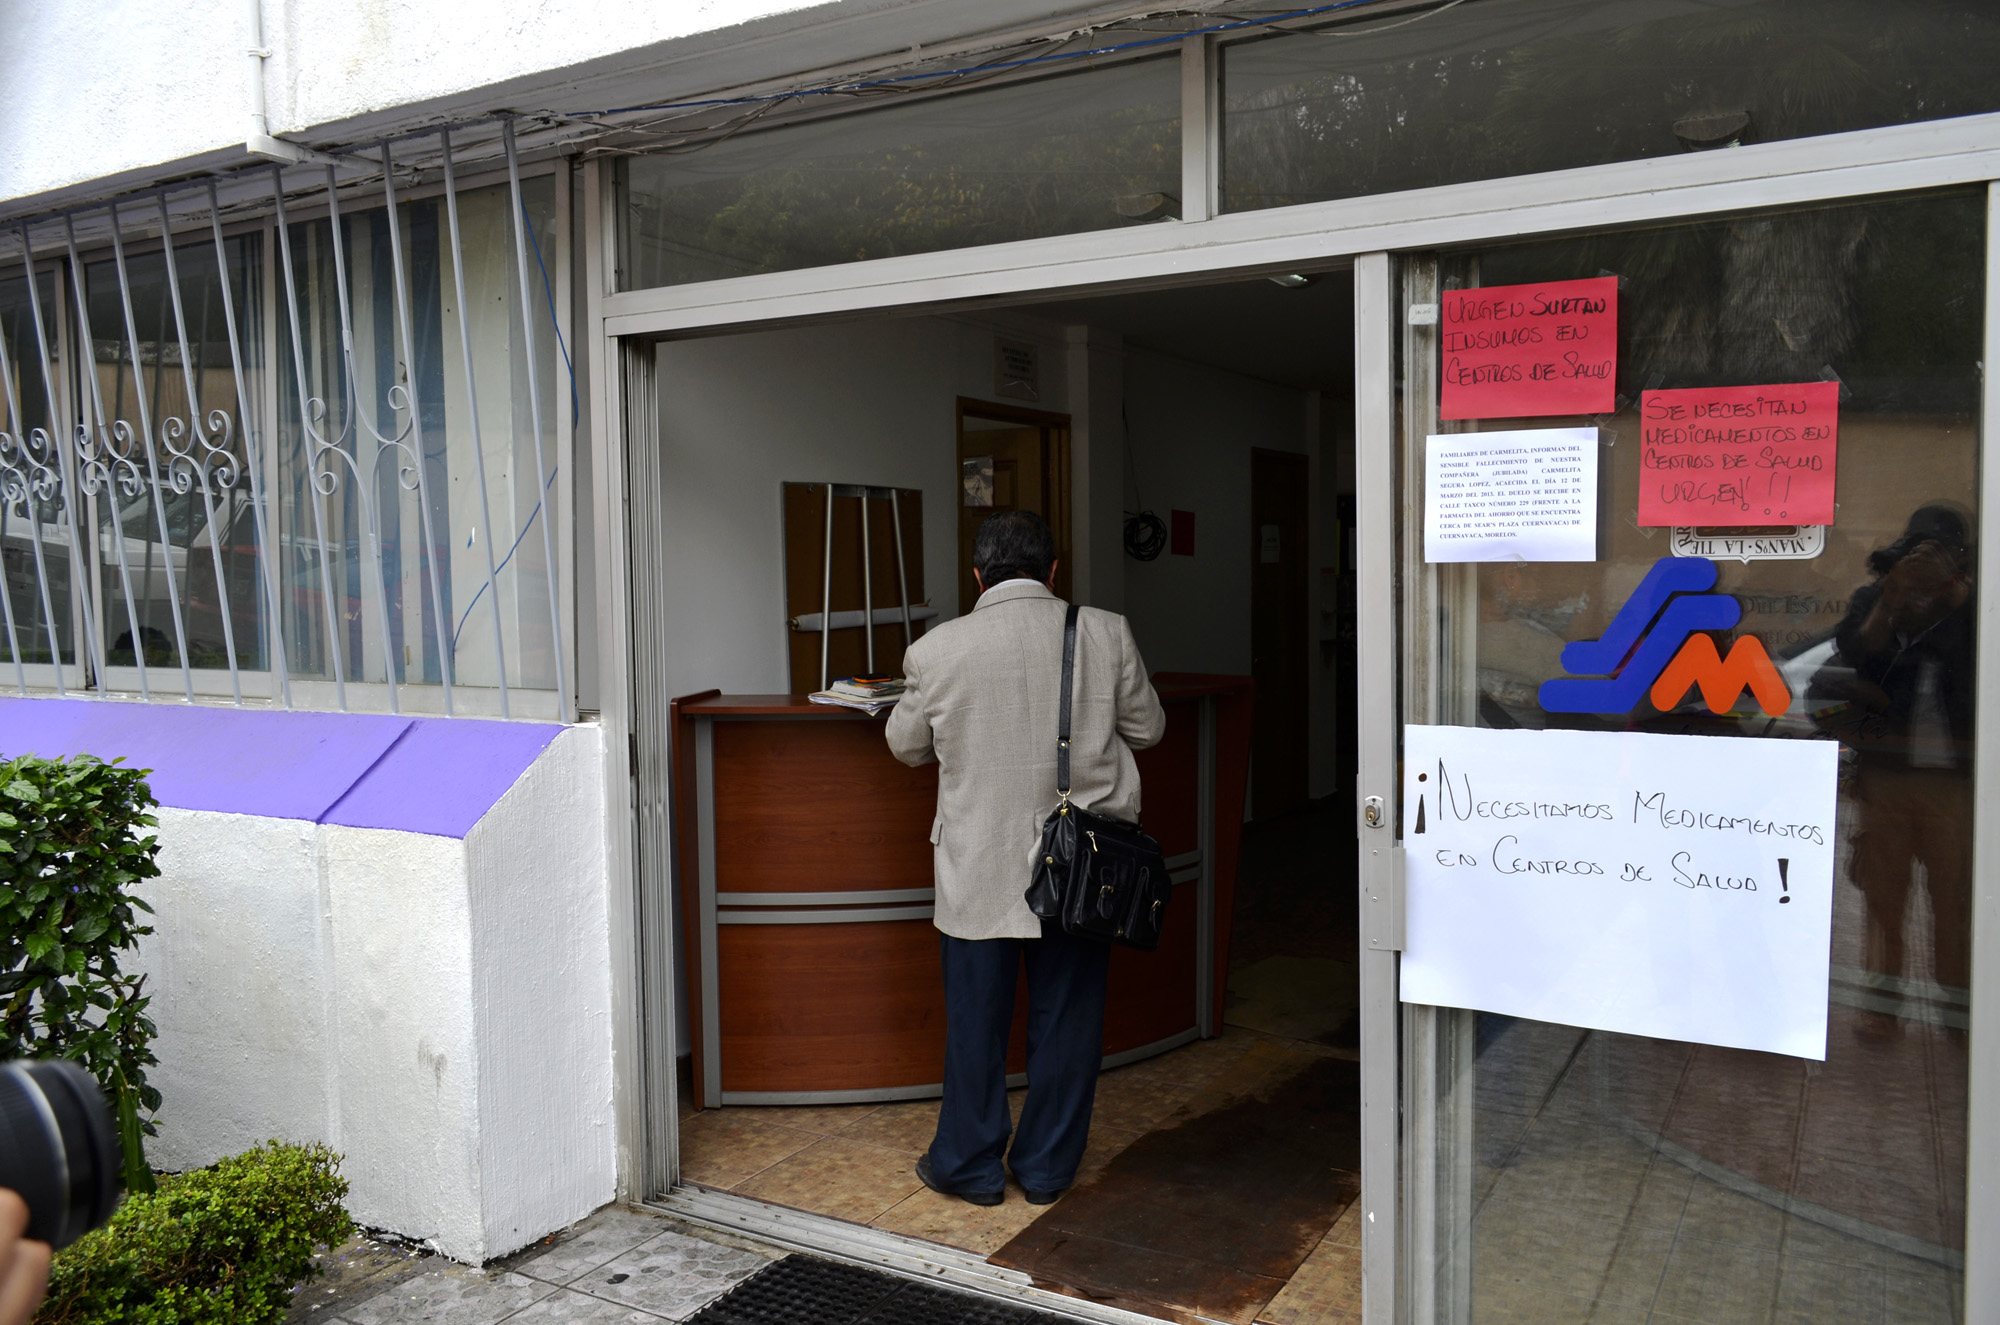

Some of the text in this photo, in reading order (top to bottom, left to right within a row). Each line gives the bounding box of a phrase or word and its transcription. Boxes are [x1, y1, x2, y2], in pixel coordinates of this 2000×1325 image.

[1448, 292, 1606, 323] URGEN SURTAN
[1445, 325, 1589, 353] INSUMOS EN
[1446, 351, 1612, 386] CENTROS DE SALUD
[1646, 396, 1688, 421] SE
[1801, 425, 1831, 441] EN
[1476, 459, 1527, 467] FALLECIMIENTO
[1490, 448, 1529, 456] CARMELITA,
[1644, 446, 1823, 471] CENTROS DE SALUD
[1492, 469, 1528, 477] (JUBILADA)
[1634, 790, 1824, 846] MEDICAMENTOS
[1436, 849, 1477, 868] EN
[1492, 835, 1604, 875] CENTROS
[1620, 863, 1652, 882] DE
